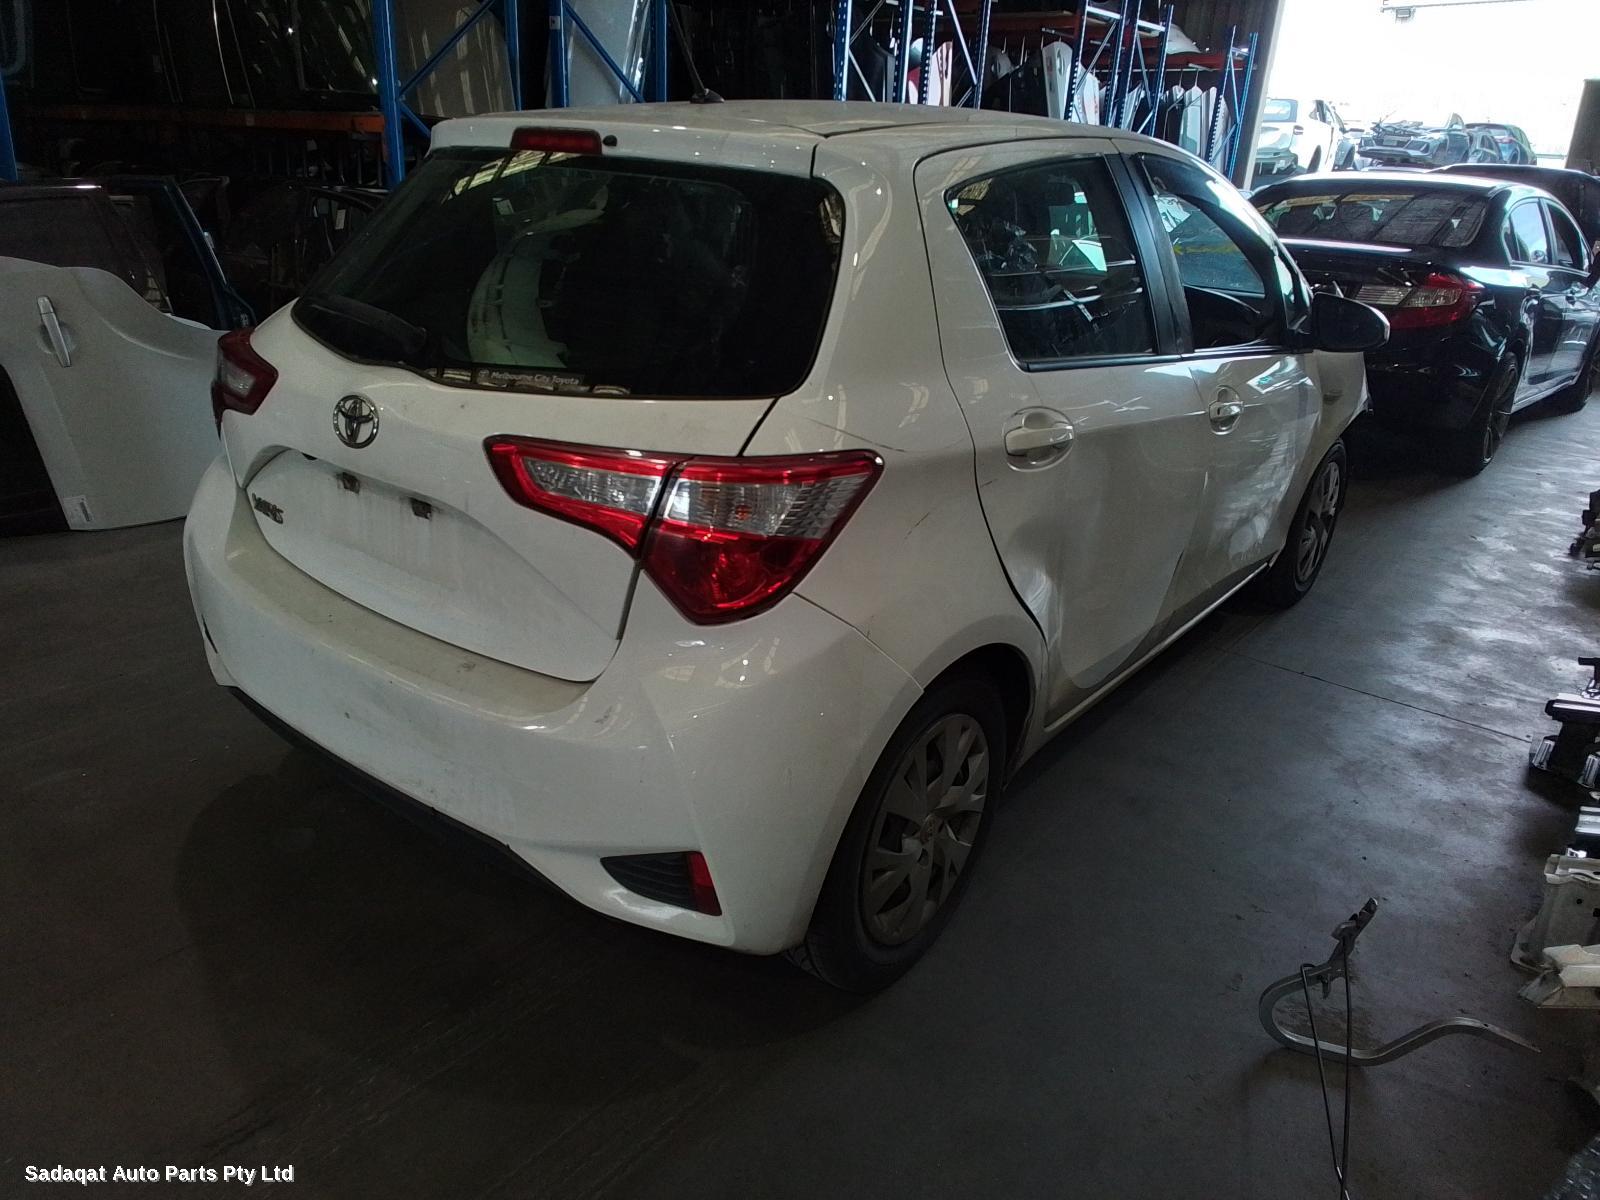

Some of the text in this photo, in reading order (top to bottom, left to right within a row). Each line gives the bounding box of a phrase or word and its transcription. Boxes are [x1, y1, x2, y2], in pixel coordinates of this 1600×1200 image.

[491, 371, 580, 386] Melbourne City Toyota
